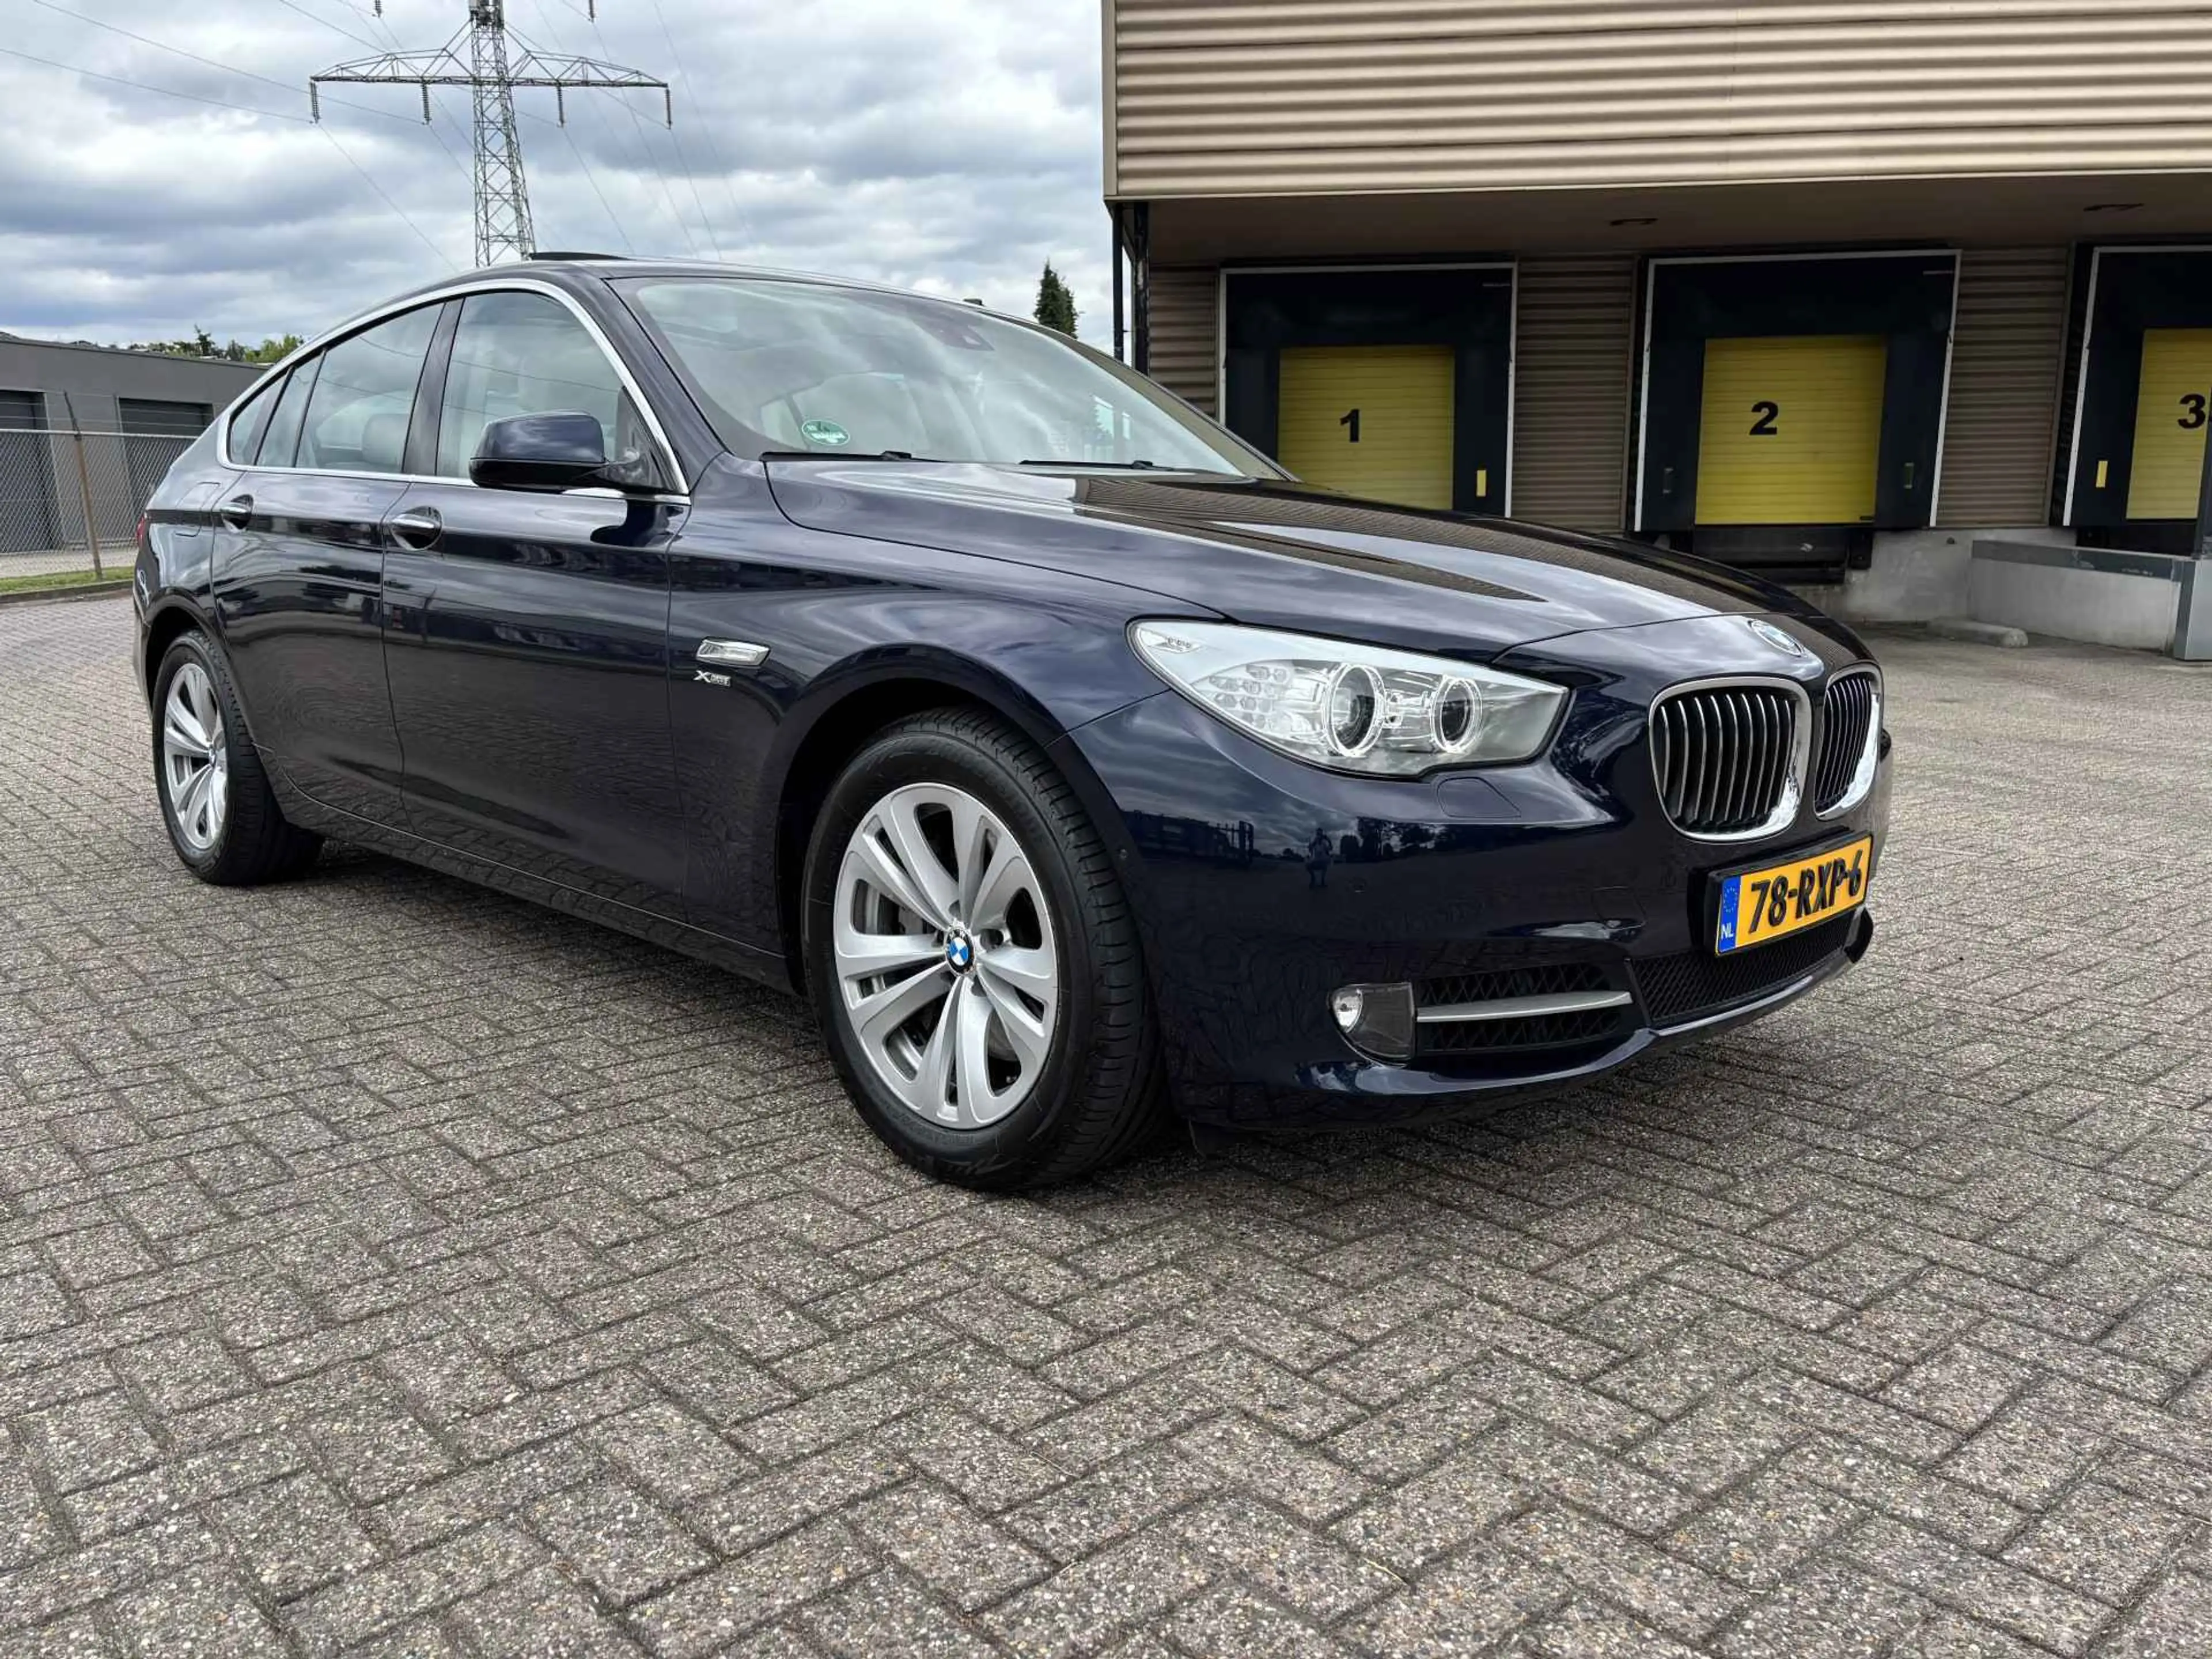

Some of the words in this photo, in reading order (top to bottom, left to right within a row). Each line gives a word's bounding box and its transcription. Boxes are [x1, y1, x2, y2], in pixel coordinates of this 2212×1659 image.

[1340, 408, 1359, 443] 1
[1749, 401, 1778, 435] 2
[2178, 394, 2206, 429] 3
[1749, 850, 1862, 933] 78-RXP-6
[1721, 922, 1734, 940] NL
